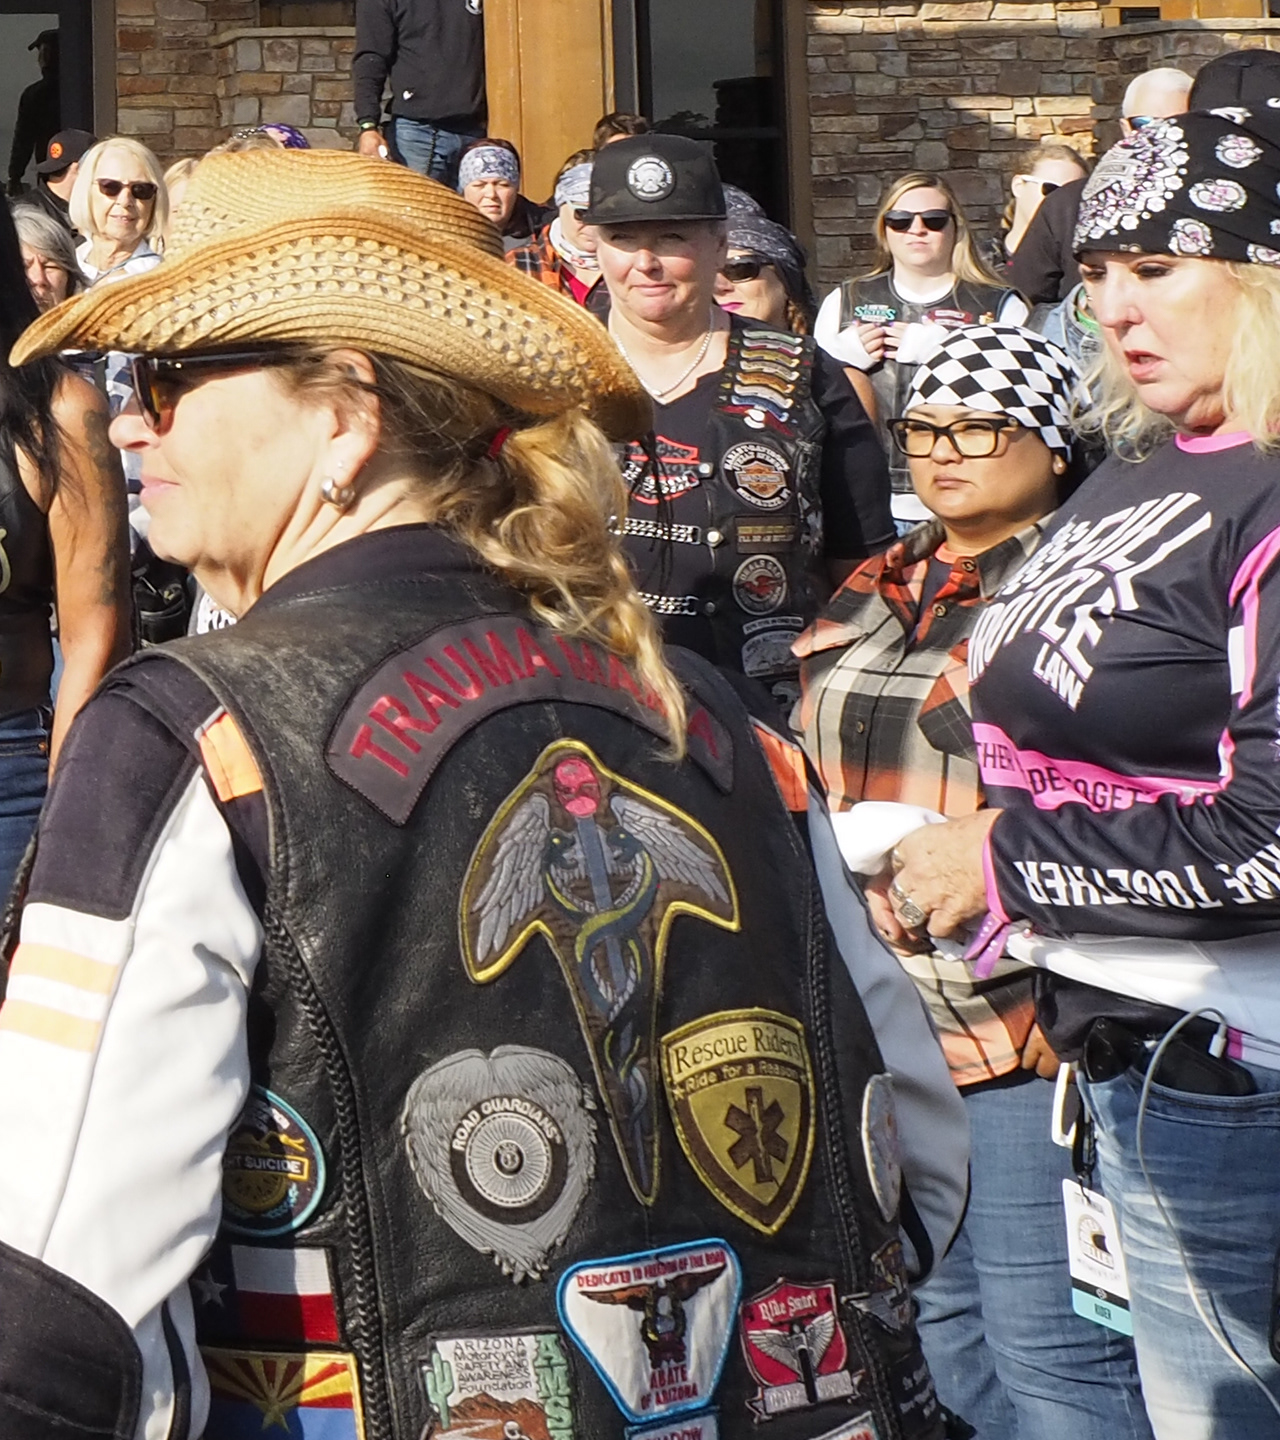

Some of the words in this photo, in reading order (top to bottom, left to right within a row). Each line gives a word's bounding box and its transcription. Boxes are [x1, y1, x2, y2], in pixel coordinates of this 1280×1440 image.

[1033, 642, 1084, 711] LAW
[349, 626, 560, 778] TRAUMA
[1014, 861, 1223, 909] TOGETHER
[673, 1034, 747, 1074] Rescue
[752, 1027, 802, 1060] Riders
[685, 1071, 718, 1093] Ride
[722, 1064, 742, 1079] for
[746, 1063, 756, 1075] a
[759, 1061, 799, 1078] Reason
[452, 1109, 481, 1151] ROAD
[480, 1098, 558, 1140] GUARDIANS
[244, 1157, 301, 1174] SUICIDE
[577, 1270, 631, 1288] DEDICATED
[632, 1267, 642, 1280] TO
[678, 1259, 689, 1271] OF
[453, 1337, 526, 1352] ARIZONA
[454, 1349, 527, 1362] Motorcycle
[456, 1361, 500, 1372] SAFETY
[505, 1360, 530, 1369] AND
[458, 1369, 531, 1382] AWARENESS
[650, 1364, 689, 1389] ABATE
[458, 1380, 533, 1393] Foundation
[641, 1392, 653, 1410] OF
[655, 1383, 699, 1406] ARIZONA
